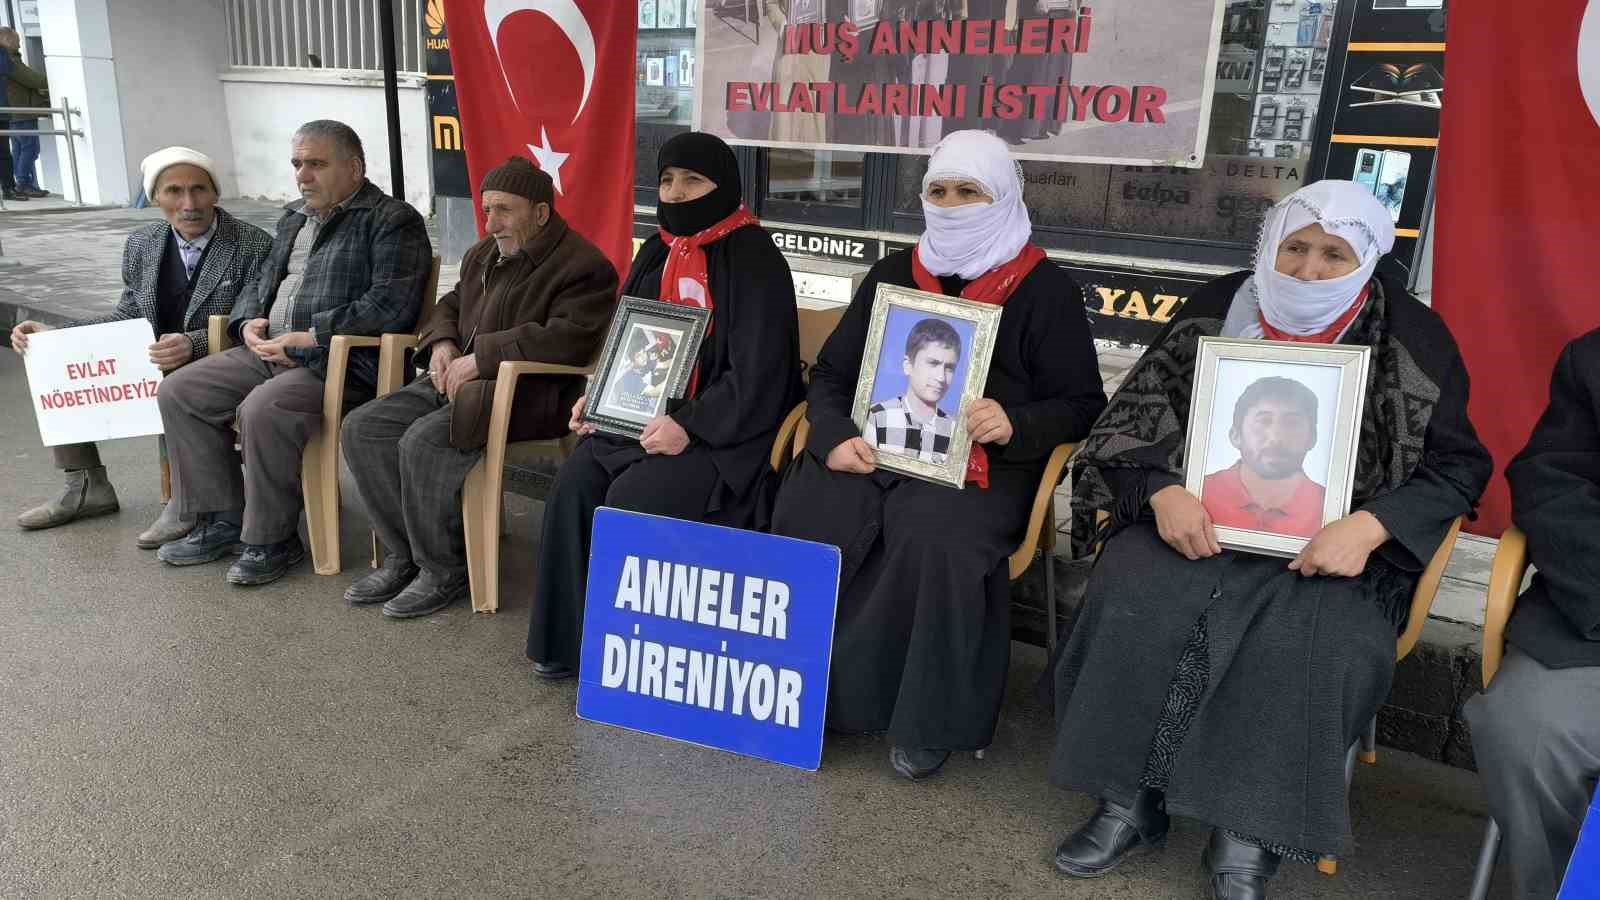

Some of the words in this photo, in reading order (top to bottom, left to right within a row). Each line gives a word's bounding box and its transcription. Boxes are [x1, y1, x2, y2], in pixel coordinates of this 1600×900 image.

[784, 20, 860, 63] MUŞ
[872, 7, 1093, 56] ANNELERİ
[726, 81, 967, 119] EVLATLARINI
[980, 76, 1168, 123] İSTİYOR
[1226, 158, 1299, 181] DELTA
[1095, 286, 1188, 323] YAZ
[66, 358, 117, 380] EVLAT
[40, 378, 158, 410] NÖBETİNDEYİZ
[614, 555, 790, 640] ANNELER
[601, 623, 802, 729] DİRENİYOR
